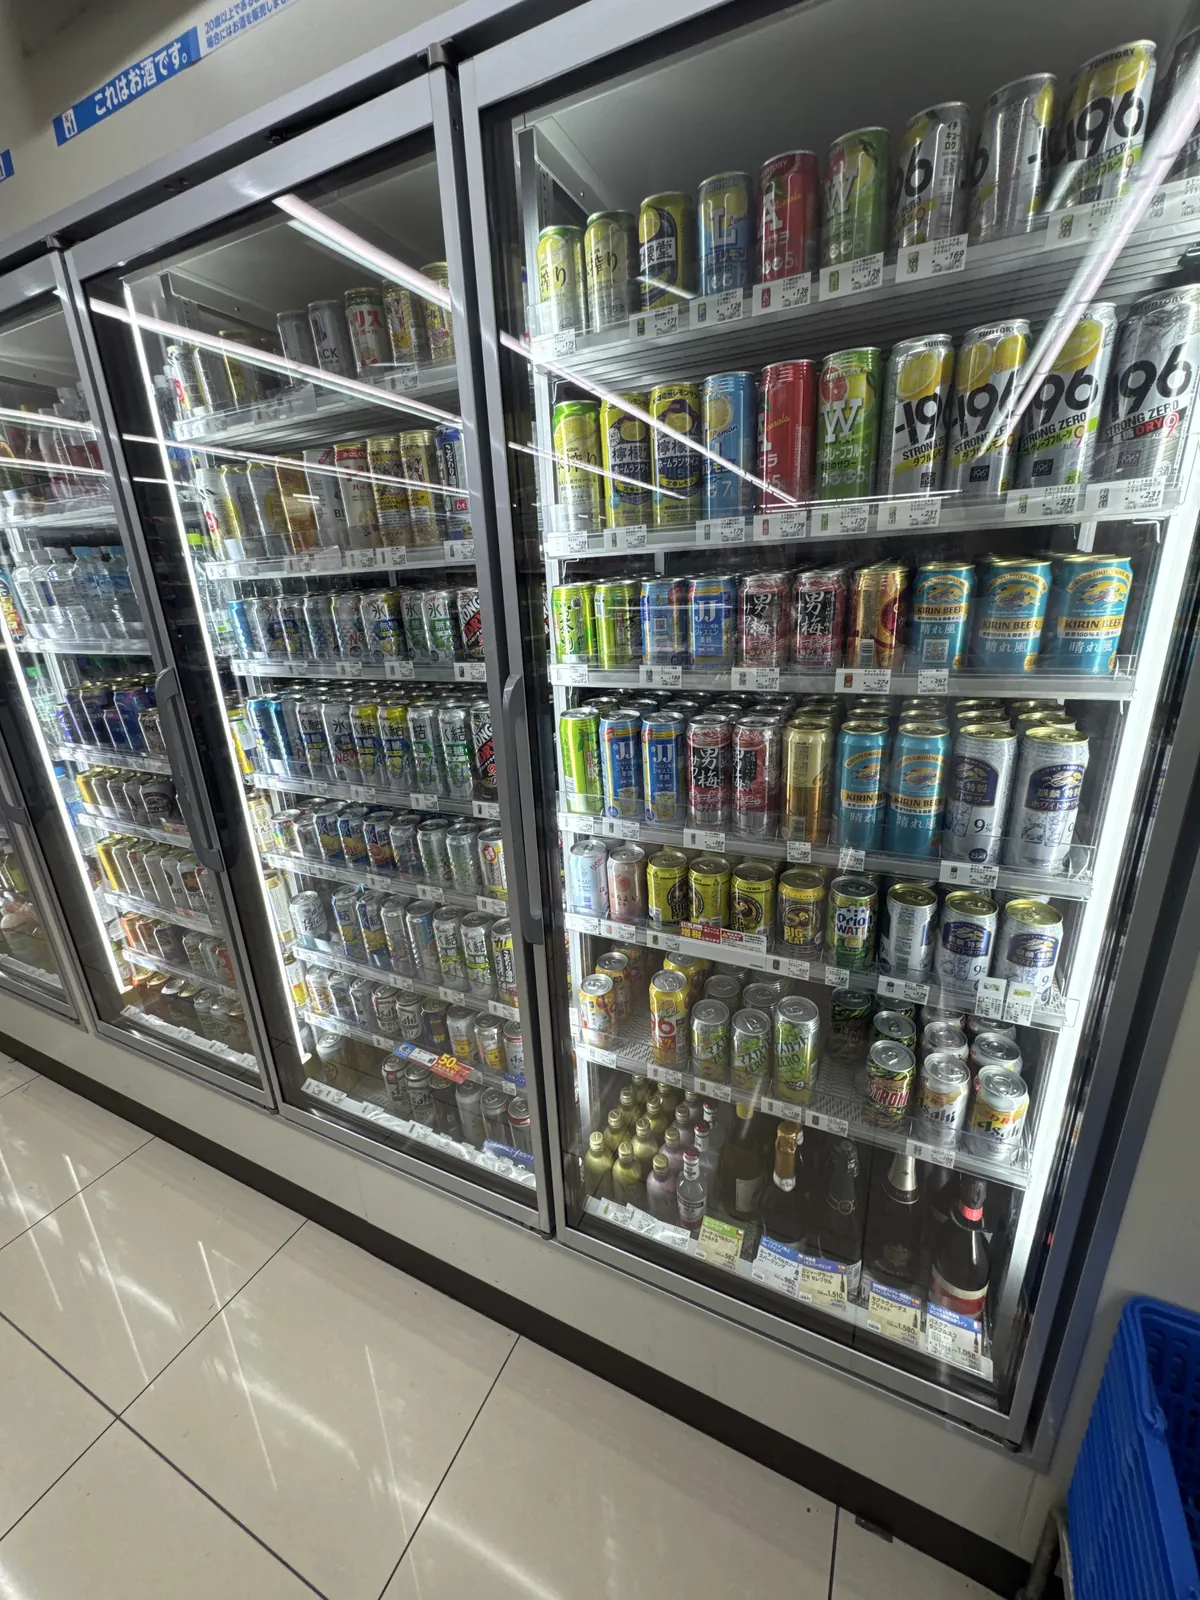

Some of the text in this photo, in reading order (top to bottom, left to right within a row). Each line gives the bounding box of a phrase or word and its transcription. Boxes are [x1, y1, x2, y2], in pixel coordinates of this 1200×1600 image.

[95, 41, 188, 116] これはお酒です。
[711, 207, 737, 248] L
[821, 397, 864, 444] W
[1058, 411, 1087, 429] ZERO
[1105, 413, 1146, 440] STRONG
[1136, 419, 1163, 437] DRY
[712, 423, 739, 441] Lemon
[694, 600, 718, 622] JJ
[917, 605, 941, 615] KIRIN
[982, 618, 1011, 631] KIRIN
[1064, 617, 1123, 629] KIRIN BEER
[615, 740, 637, 760] JJ
[652, 743, 675, 763] JJ
[697, 746, 720, 789] 男梅
[846, 792, 874, 802] KIRIN
[894, 795, 920, 807] KIRIN
[974, 818, 986, 833] 9
[783, 925, 804, 938] BIG
[783, 937, 805, 945] PEAT
[438, 1053, 457, 1068] 50
[778, 1053, 801, 1068] ZERO
